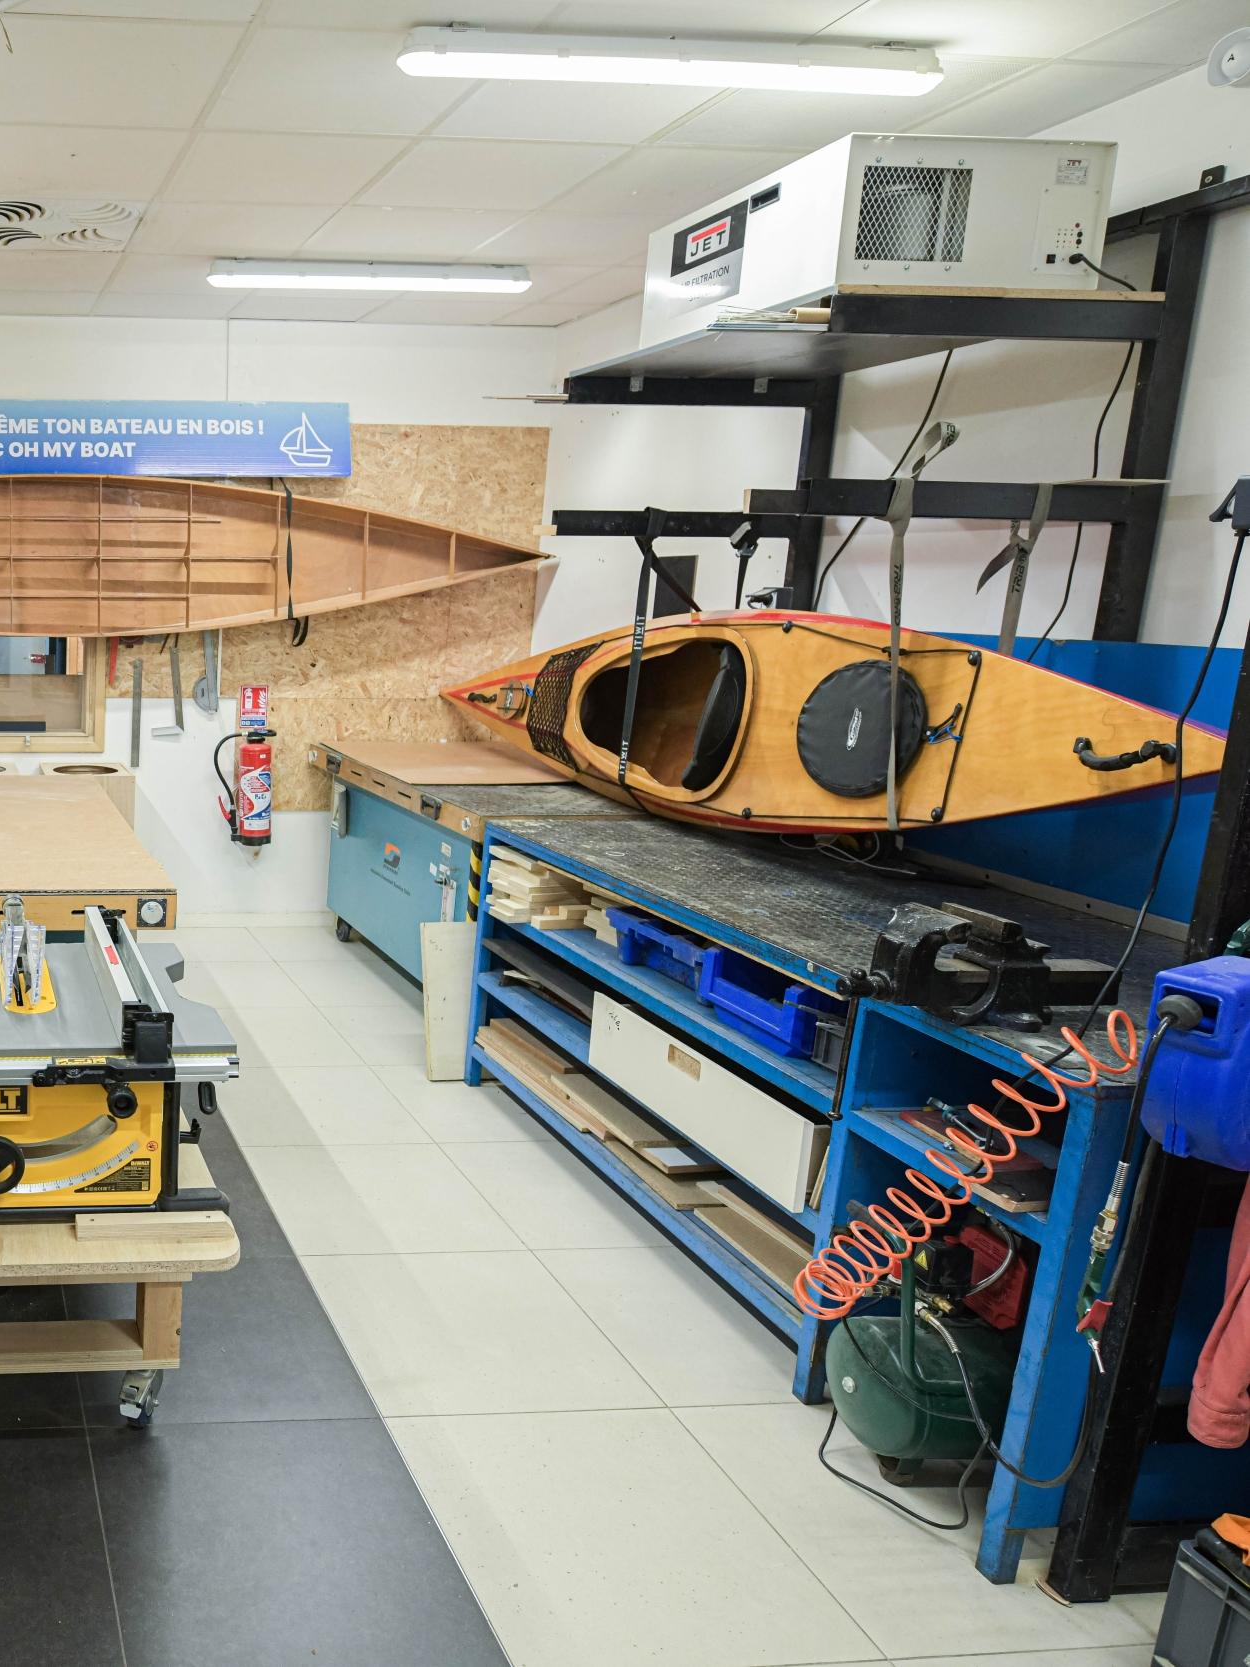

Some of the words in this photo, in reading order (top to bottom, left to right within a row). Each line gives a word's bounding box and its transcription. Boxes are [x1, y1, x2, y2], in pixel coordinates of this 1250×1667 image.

[690, 228, 727, 257] JET
[691, 265, 730, 287] FILTRATION
[42, 418, 86, 435] TON
[90, 418, 173, 435] BATEAU
[176, 418, 204, 435] EN
[206, 419, 254, 436] BOIS
[8, 441, 39, 458] OH
[43, 441, 78, 458] MY
[81, 441, 136, 458] BOAT
[633, 615, 646, 650] ITIWIT
[619, 740, 630, 775] ITIWIT
